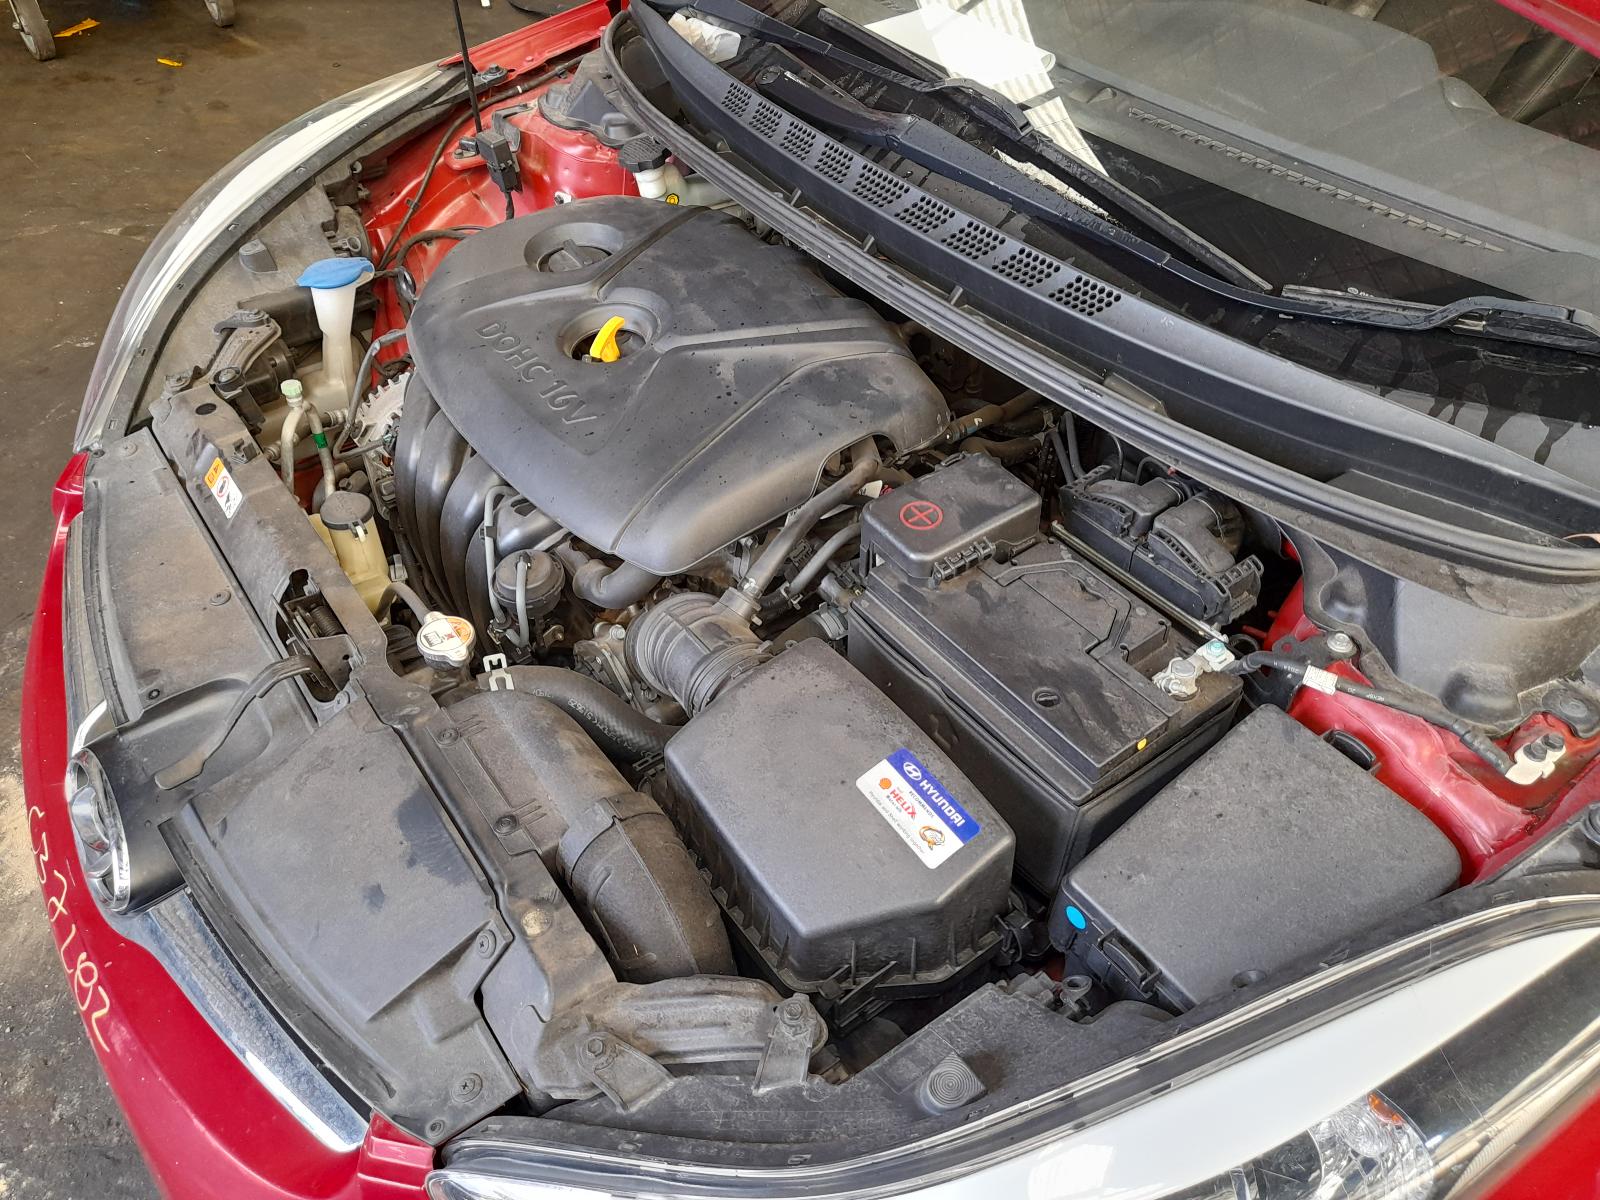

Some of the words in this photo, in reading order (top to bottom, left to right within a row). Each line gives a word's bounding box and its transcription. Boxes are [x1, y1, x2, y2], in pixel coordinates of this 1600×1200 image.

[474, 323, 552, 383] DOHC
[539, 380, 598, 425] 16V
[889, 788, 918, 820] HELIX
[908, 790, 935, 818] RECOMMENDS
[919, 779, 966, 827] HYUNDAI
